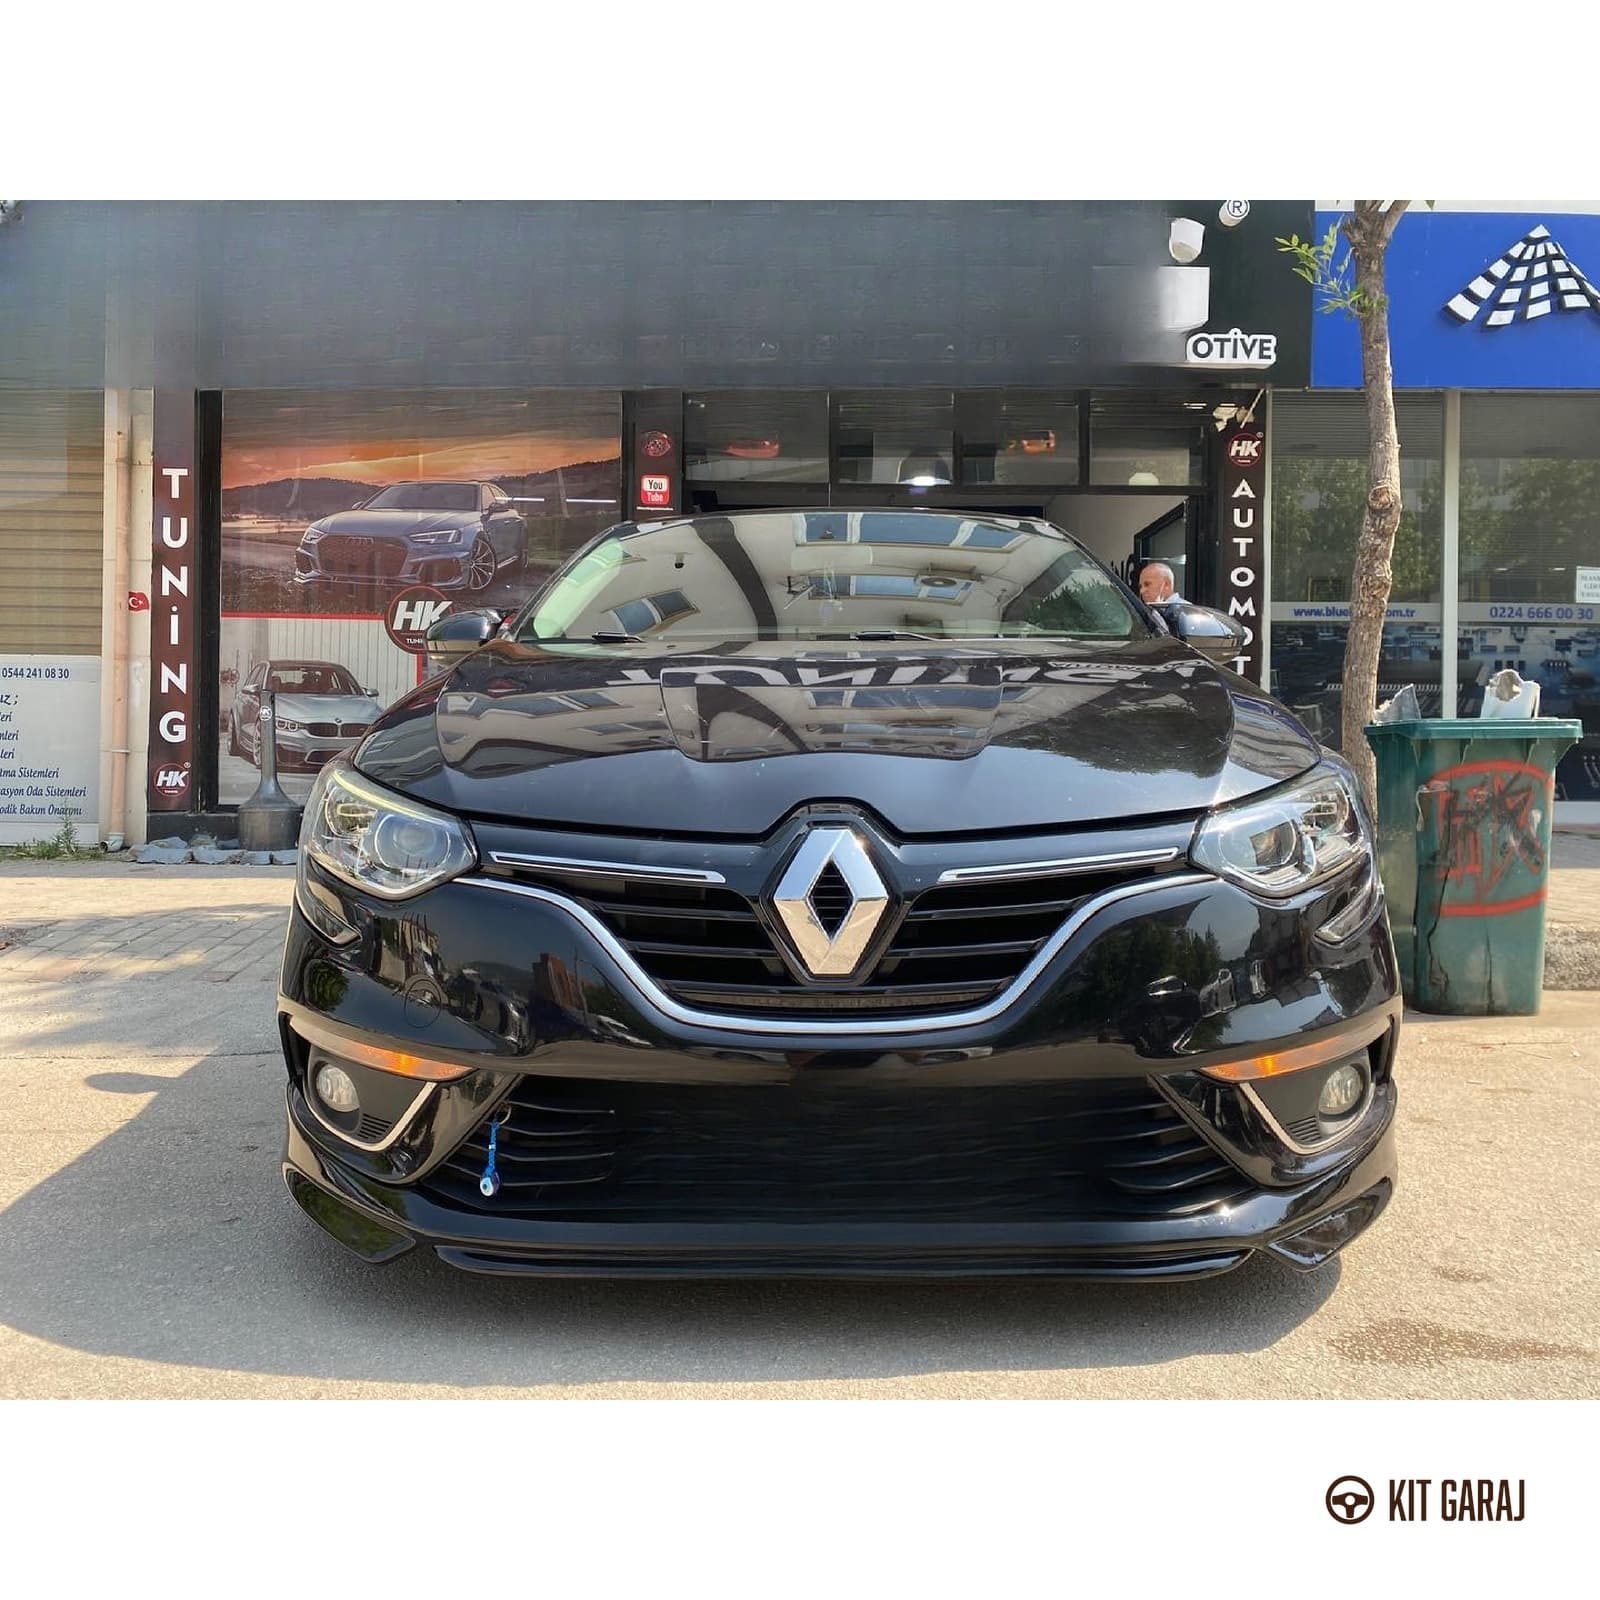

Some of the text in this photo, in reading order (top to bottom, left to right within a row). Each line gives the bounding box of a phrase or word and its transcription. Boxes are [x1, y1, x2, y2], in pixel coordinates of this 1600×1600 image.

[1231, 440, 1261, 457] HK
[648, 480, 663, 490] You
[646, 492, 664, 502] Tube
[392, 600, 454, 631] HK
[1490, 606, 1593, 620] 0224 666 00 30
[2, 667, 70, 679] 0544 241 08 30
[18, 767, 60, 779] Sistemleri
[156, 770, 189, 787] HK
[26, 785, 44, 797] Oda
[45, 785, 87, 797] Sistemleri
